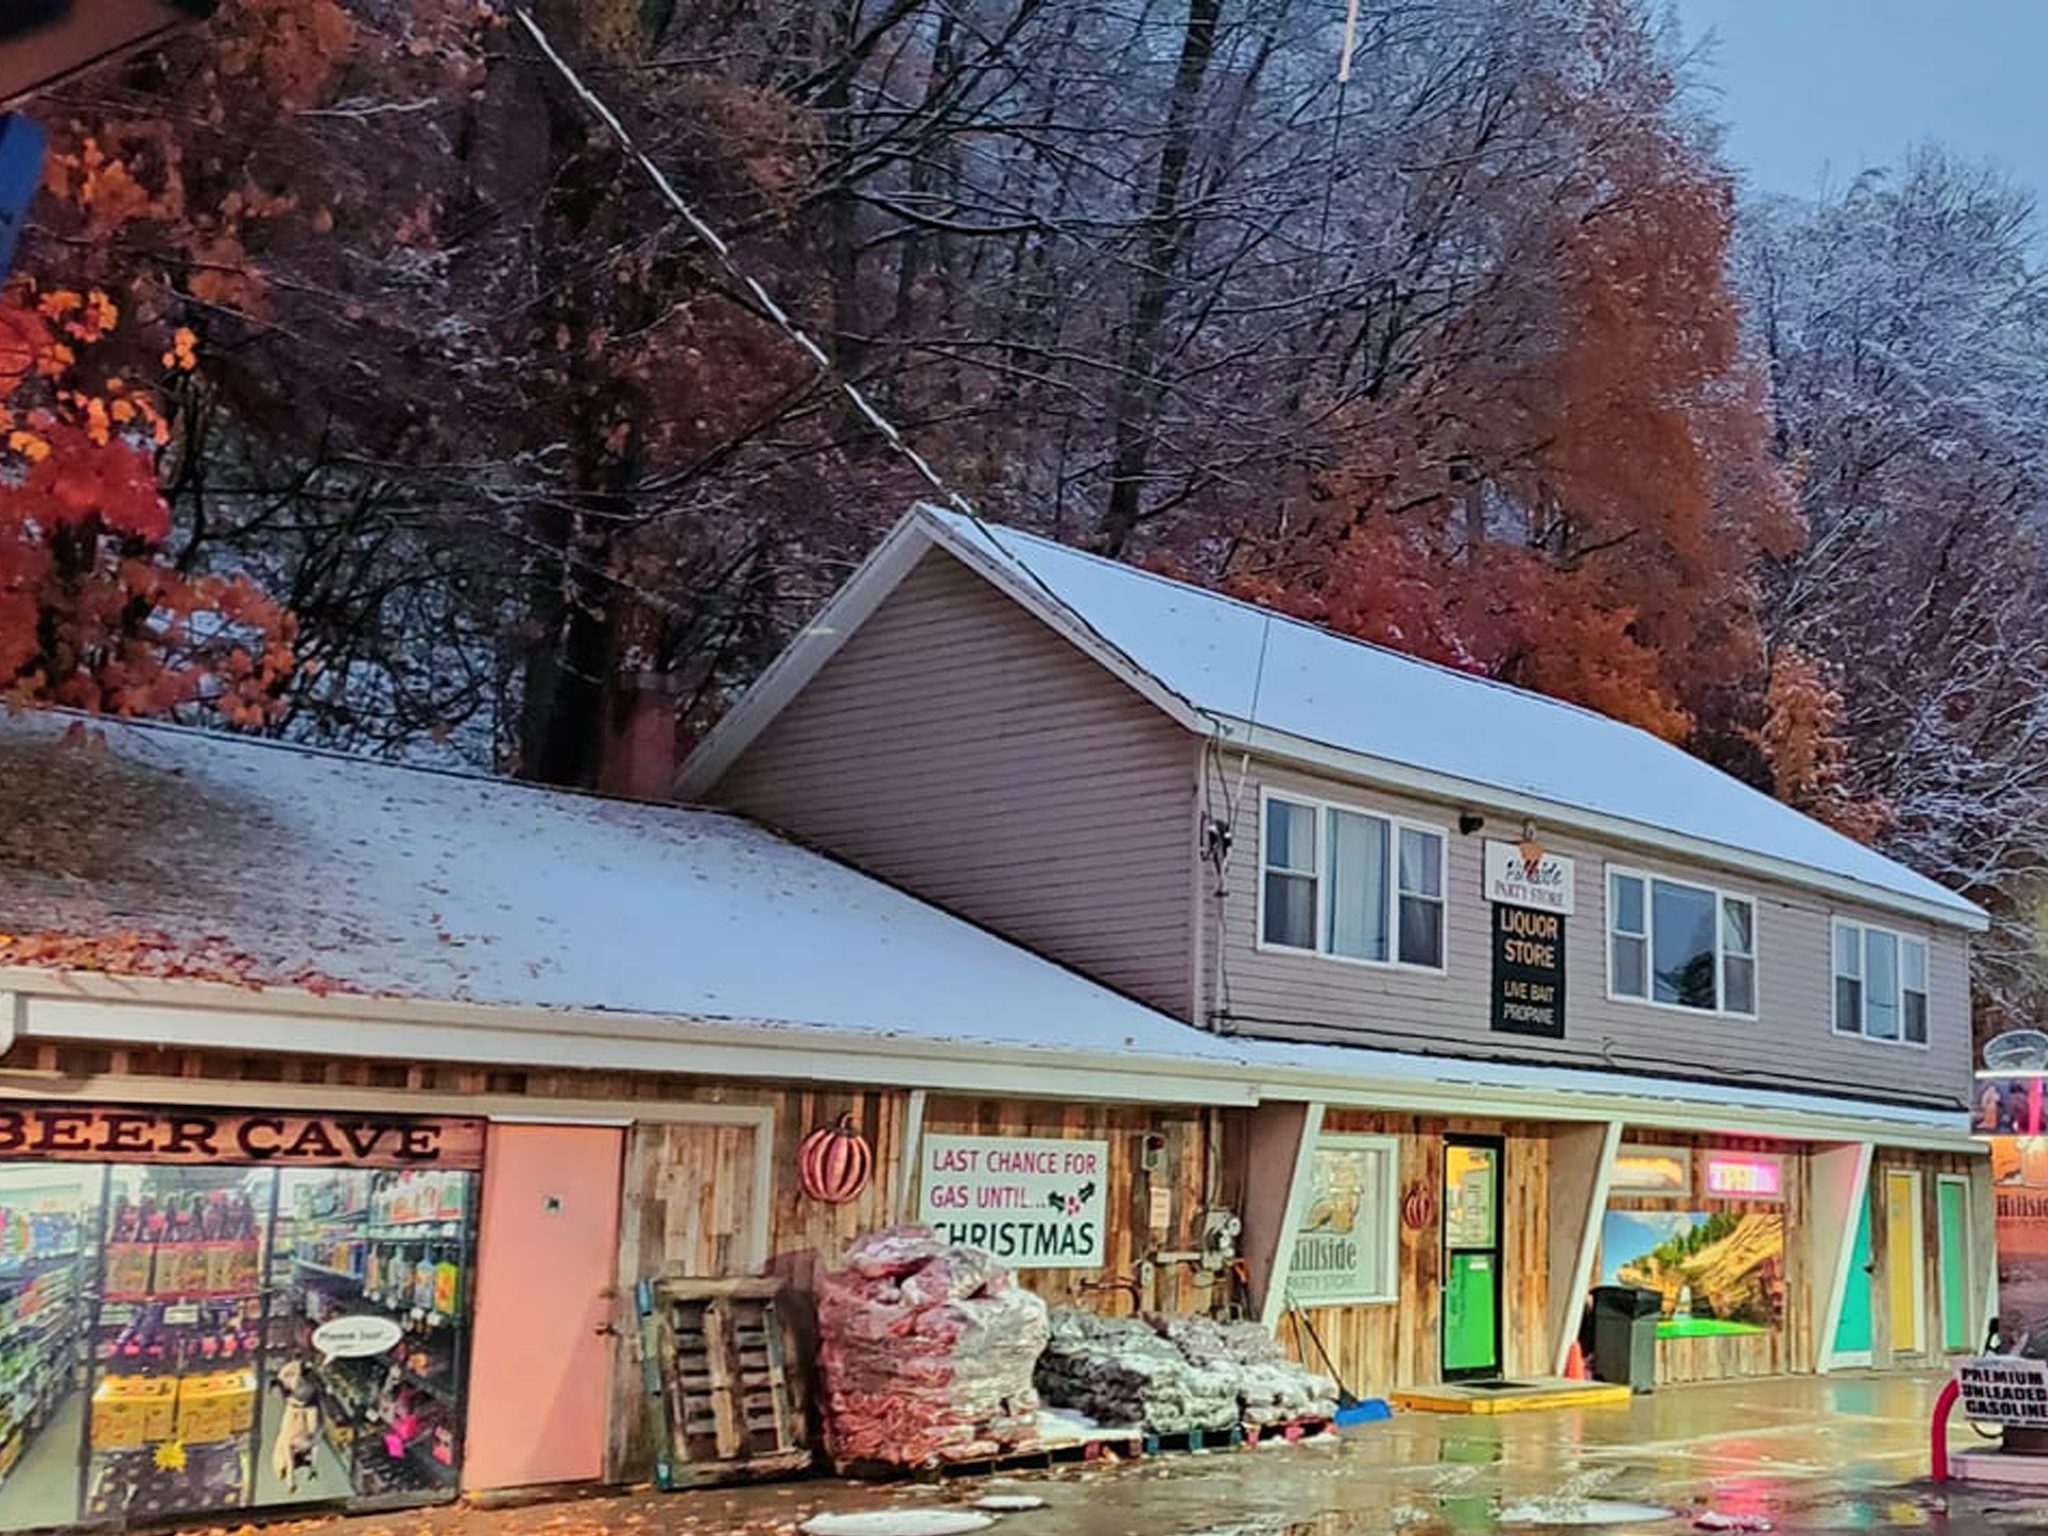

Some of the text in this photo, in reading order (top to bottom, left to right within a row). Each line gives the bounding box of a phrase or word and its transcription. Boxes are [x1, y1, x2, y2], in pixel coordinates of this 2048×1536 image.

[1501, 908, 1558, 940] LIQUOR
[1504, 939, 1555, 969] STORE
[1504, 981, 1555, 1003] LIVE BAIT
[1503, 1003, 1555, 1026] PROPANE
[237, 1118, 441, 1159] CAVE
[933, 1149, 1097, 1175] LAST CHANCE FOR
[931, 1186, 1046, 1209] GAS UNTIL...
[934, 1223, 1095, 1256] HRISTMAS
[1961, 1368, 2043, 1385] PREMIUM
[1961, 1384, 2048, 1401] UNLEADED
